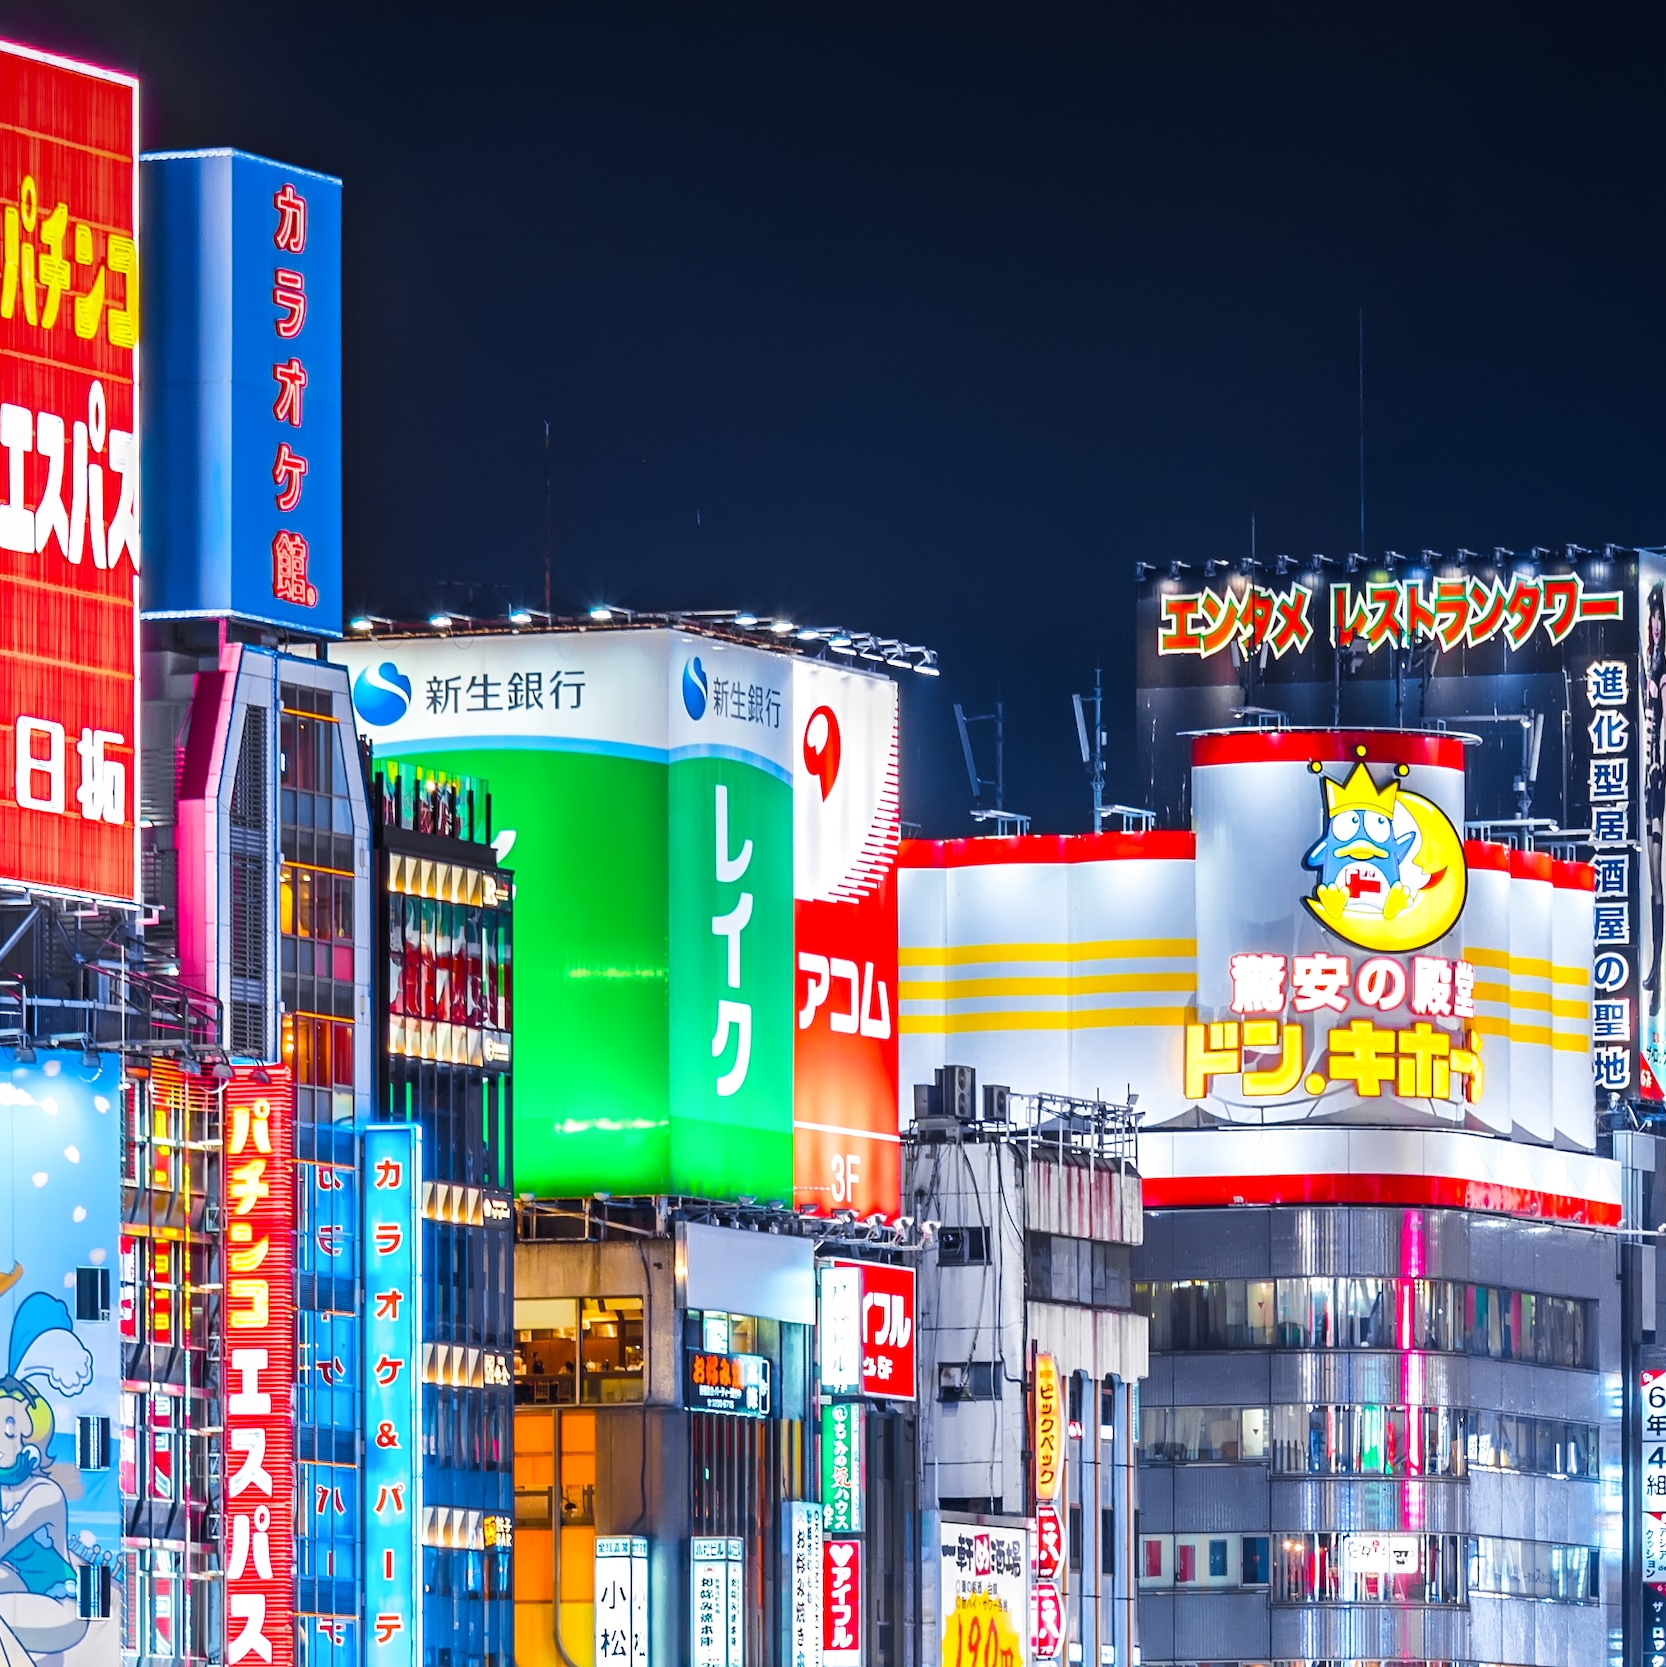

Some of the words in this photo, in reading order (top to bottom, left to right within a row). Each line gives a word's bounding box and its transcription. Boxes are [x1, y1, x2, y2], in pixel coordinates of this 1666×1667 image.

[0, 174, 136, 349] パチンコ
[271, 182, 313, 608] カラオケ館
[1157, 582, 1313, 657] エンタメ
[1329, 572, 1625, 653] レストランタワー
[424, 669, 587, 716] 新生銀行
[713, 676, 783, 730] 新生銀行
[15, 715, 126, 825] 日拓
[1588, 659, 1631, 1091] 進化型居酒屋の聖地
[711, 783, 754, 1098] レイク
[1228, 953, 1476, 1015] 驚安の殿堂
[797, 951, 892, 1041] アコム
[830, 1153, 861, 1203] 3F
[830, 1566, 854, 1649] アイフル
